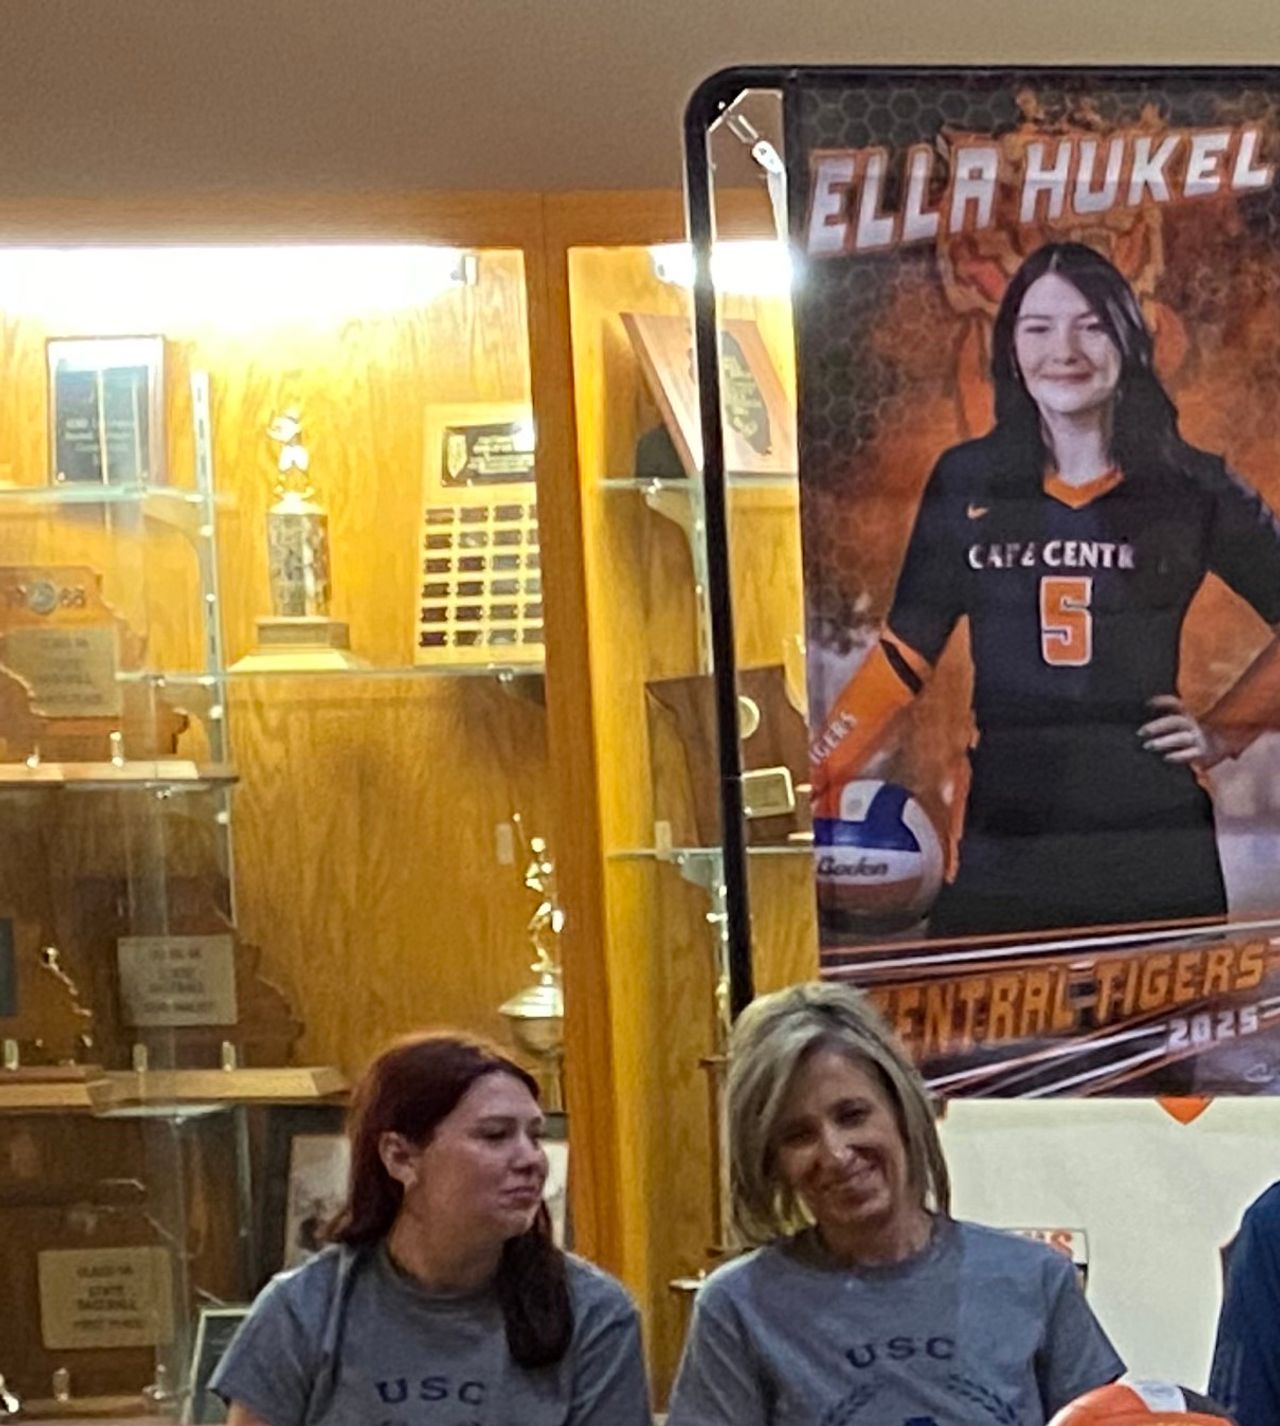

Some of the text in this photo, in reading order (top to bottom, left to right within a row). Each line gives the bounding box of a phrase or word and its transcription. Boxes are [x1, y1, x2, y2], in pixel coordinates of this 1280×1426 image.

[807, 130, 1275, 256] ELLA HUKEL
[1040, 575, 1093, 666] 5
[1095, 940, 1271, 1024] TIGERS
[1166, 1006, 1260, 1051] 2025
[846, 1335, 957, 1370] USC
[375, 1378, 488, 1405] USC
